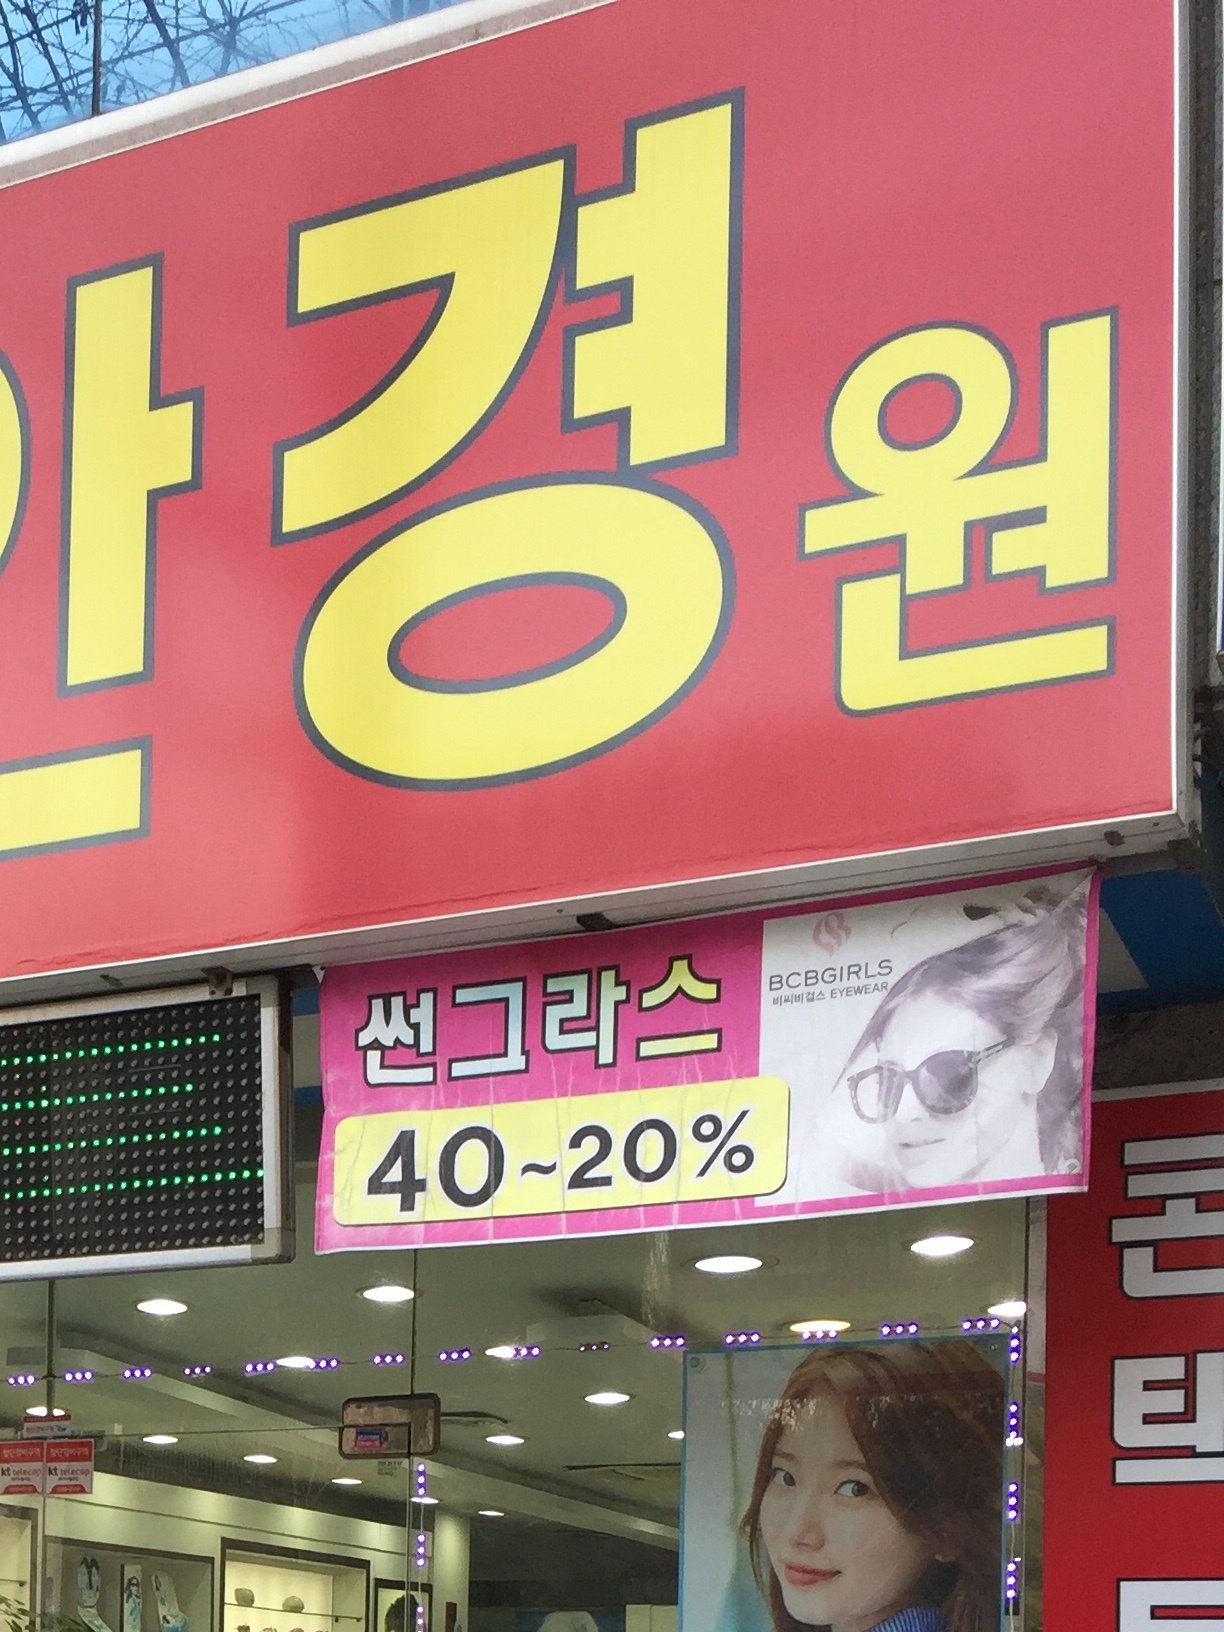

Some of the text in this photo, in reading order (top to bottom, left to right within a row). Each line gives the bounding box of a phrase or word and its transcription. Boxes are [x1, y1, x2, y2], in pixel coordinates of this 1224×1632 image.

[769, 959, 893, 991] BCBGIRLS
[772, 981, 889, 1006] 비씨비걸스 EYEWEAR
[355, 952, 722, 1089] 썬그라스
[367, 1107, 756, 1213] 40~20%
